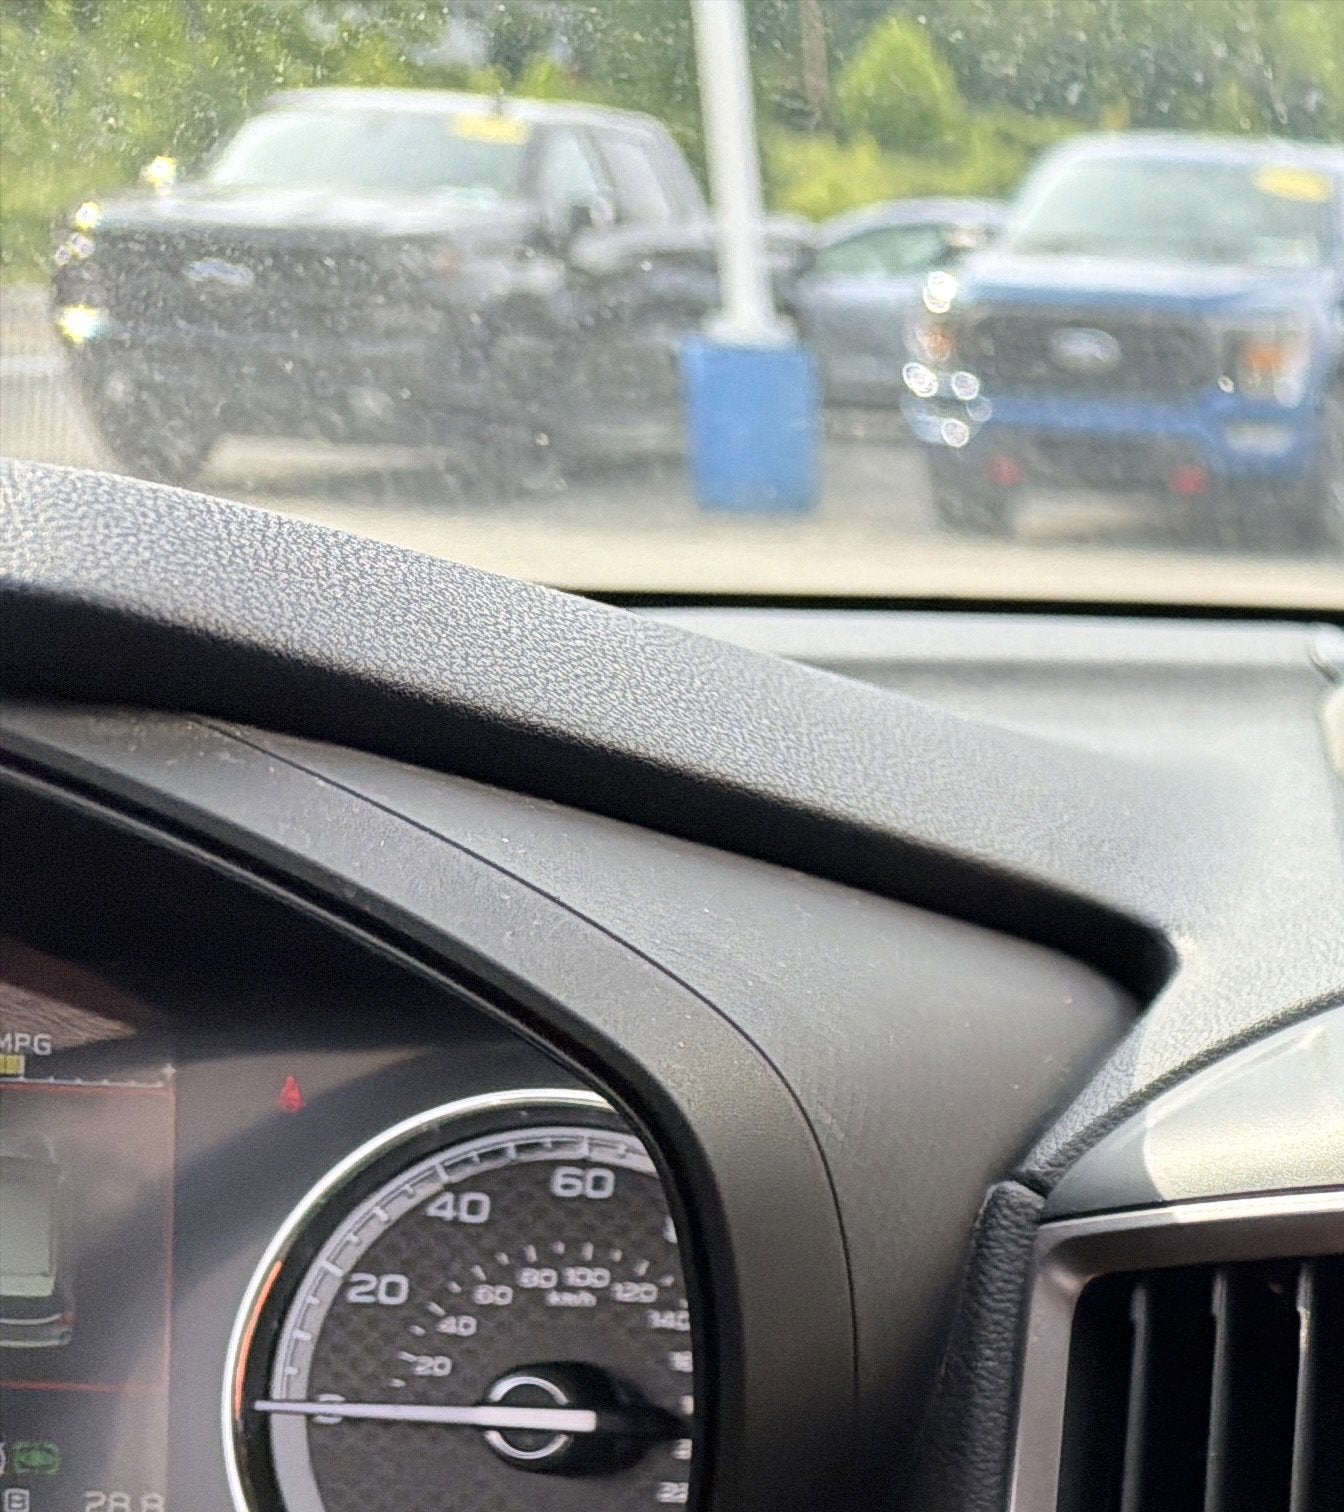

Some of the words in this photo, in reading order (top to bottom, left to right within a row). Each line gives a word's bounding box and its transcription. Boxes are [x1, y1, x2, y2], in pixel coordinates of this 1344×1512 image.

[0, 1032, 53, 1056] MPG
[552, 1166, 616, 1199] 60
[426, 1191, 492, 1224] 40
[347, 1272, 410, 1306] 20
